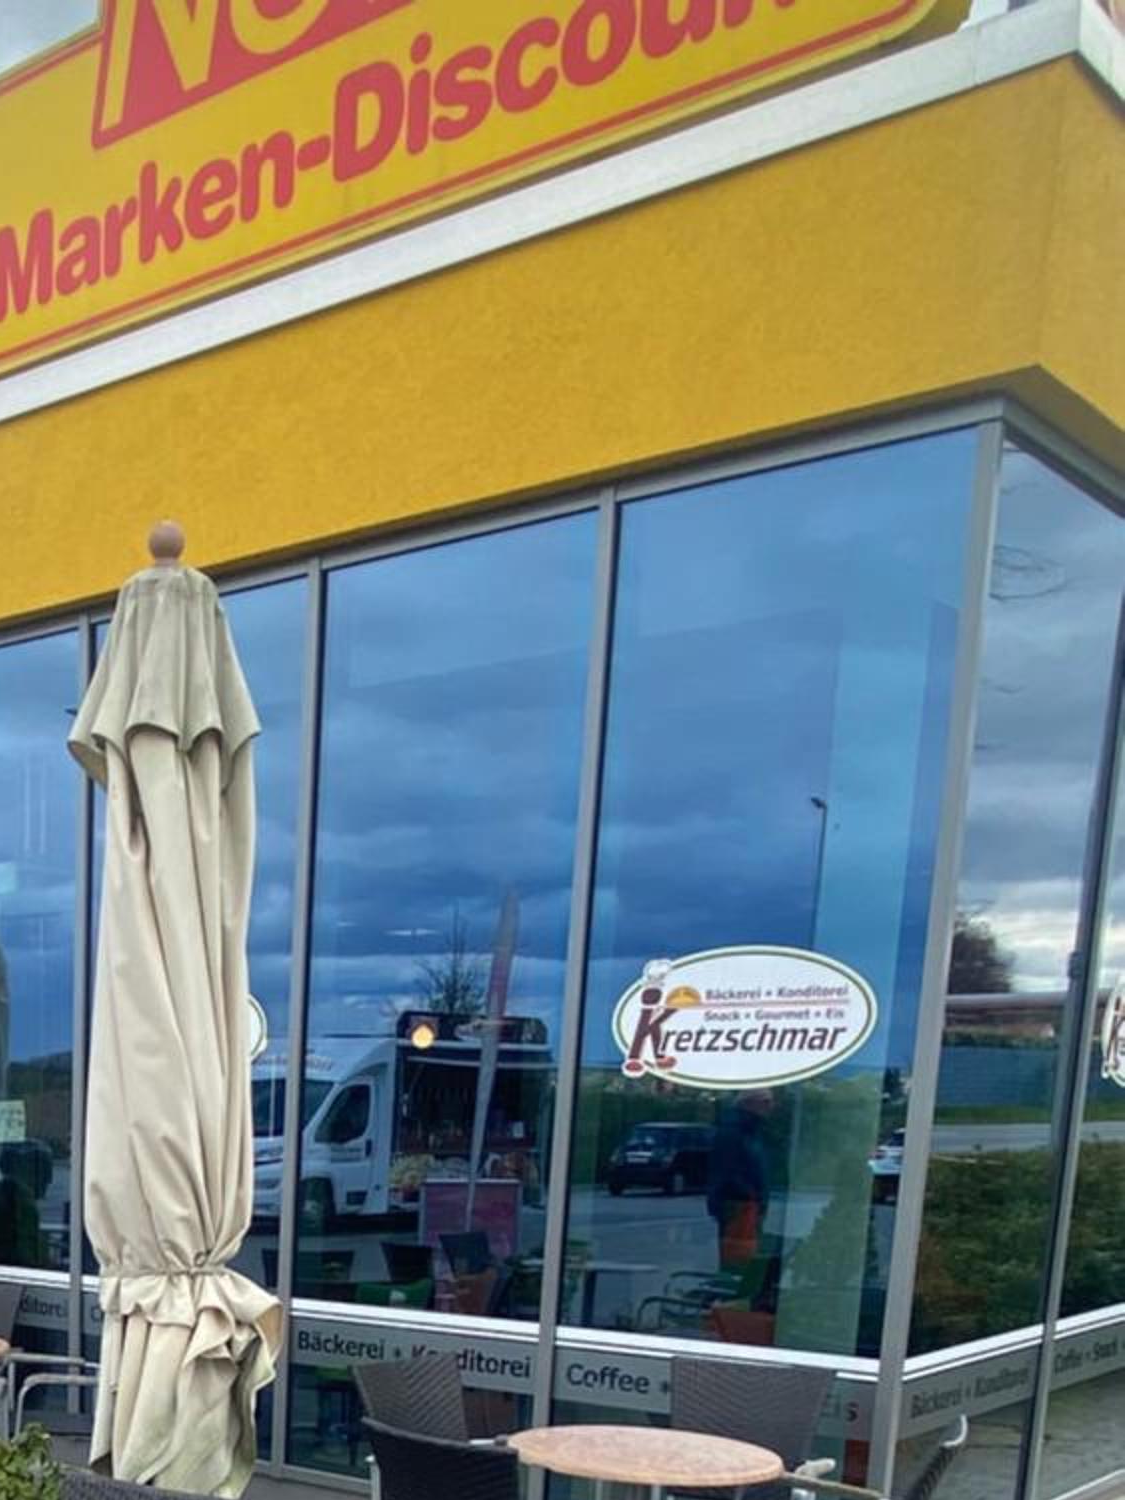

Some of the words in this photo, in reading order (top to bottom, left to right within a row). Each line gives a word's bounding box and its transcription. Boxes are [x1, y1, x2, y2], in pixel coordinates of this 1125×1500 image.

[776, 985, 849, 998] Konditorei
[625, 1007, 847, 1067] Kretzschmar
[297, 1329, 386, 1360] Bäckerei
[411, 1344, 531, 1379] Kditorei
[566, 1363, 651, 1394] Coffee
